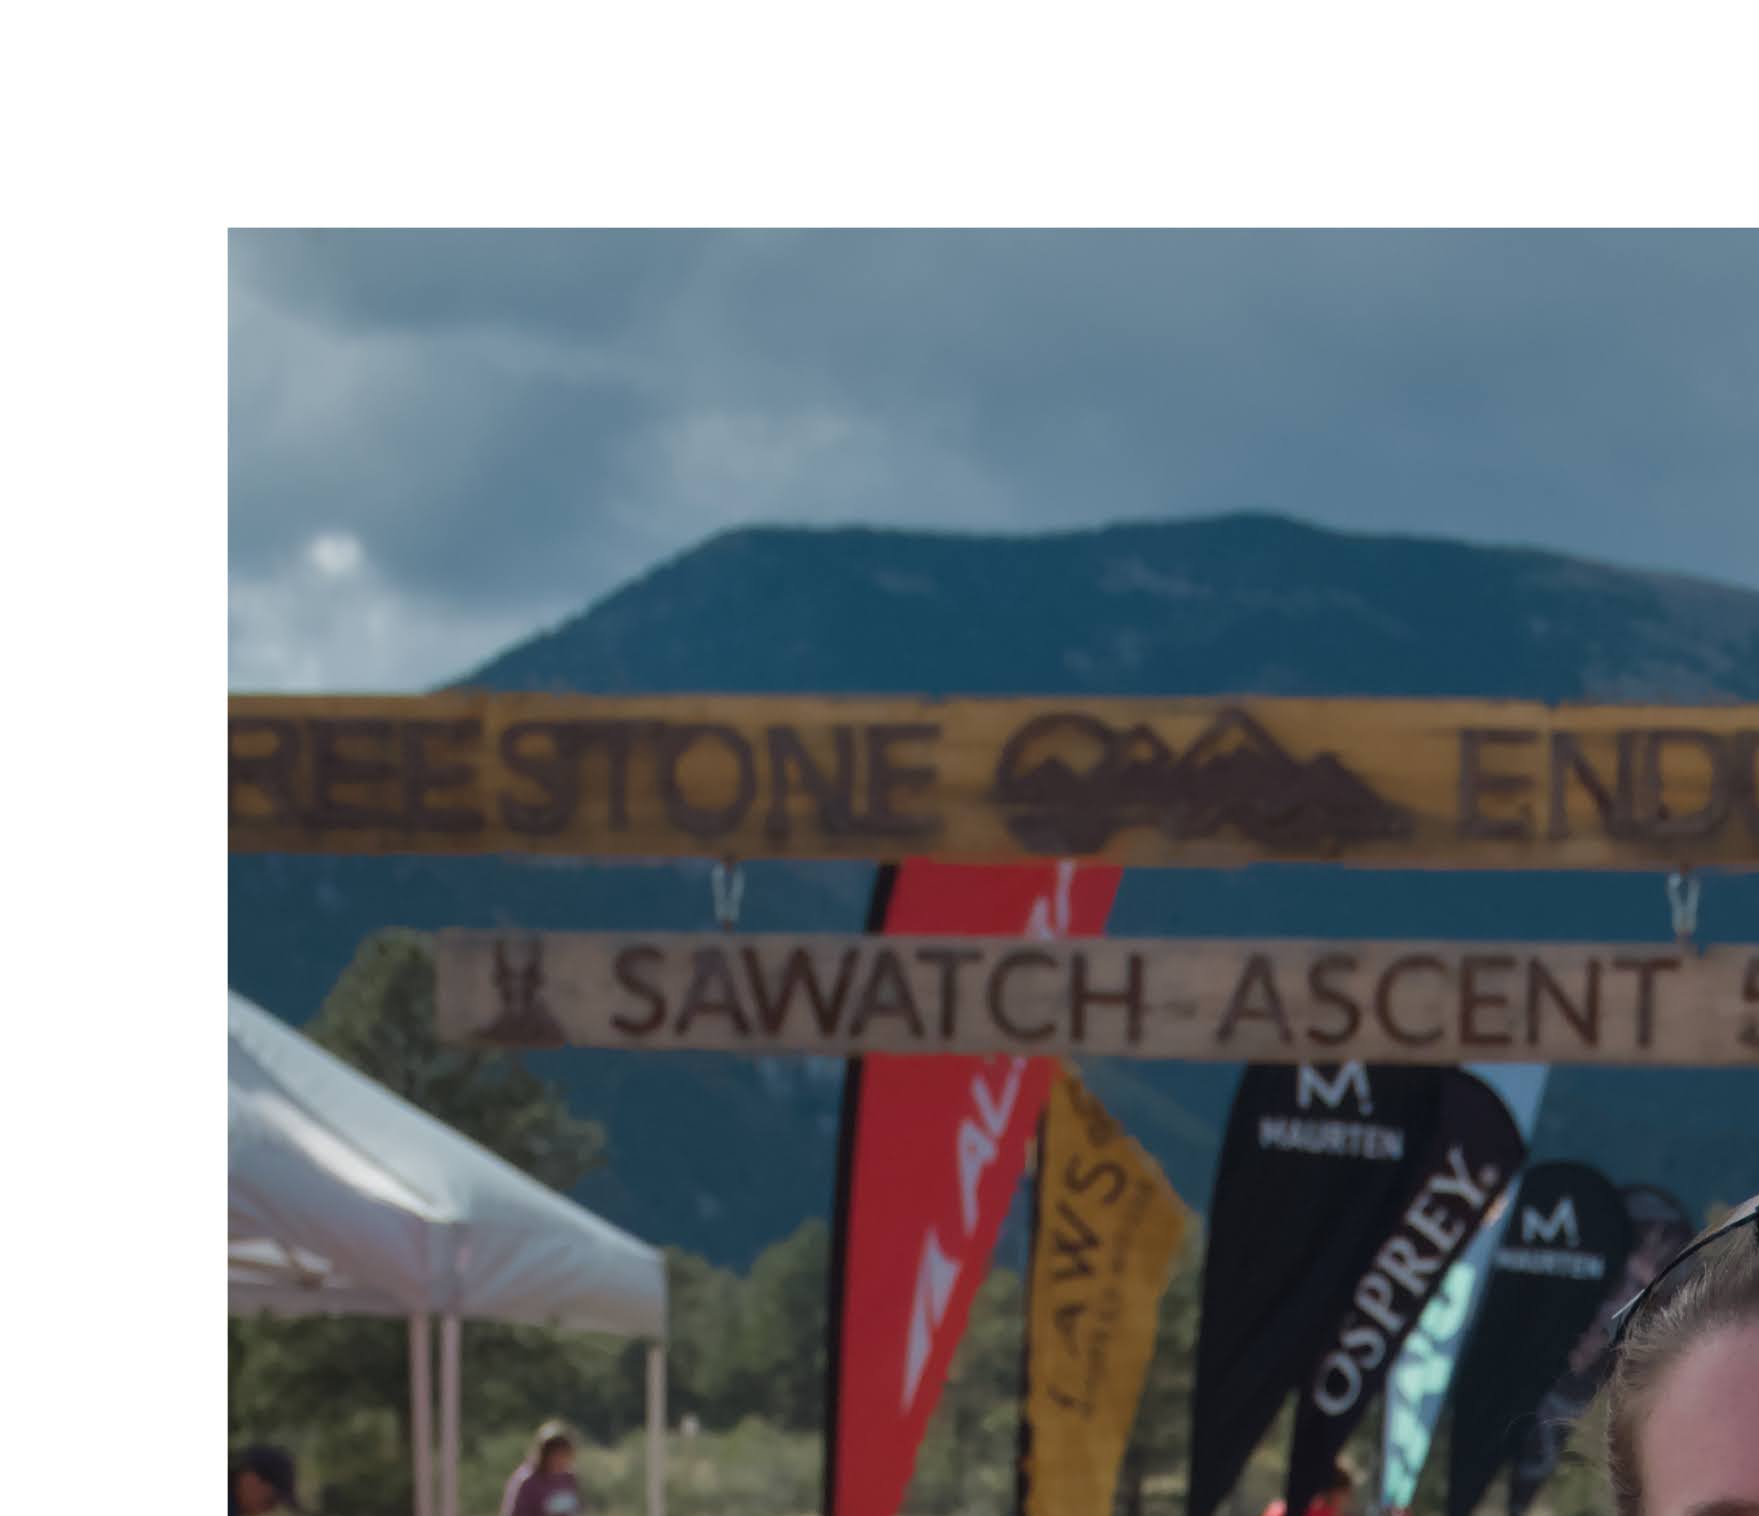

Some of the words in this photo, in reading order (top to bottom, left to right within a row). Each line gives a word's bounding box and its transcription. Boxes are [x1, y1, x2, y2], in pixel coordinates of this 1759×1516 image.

[610, 948, 1146, 1046] SAWATCH
[1215, 954, 1678, 1051] ASCENT
[1258, 1120, 1404, 1161] MAURTEN
